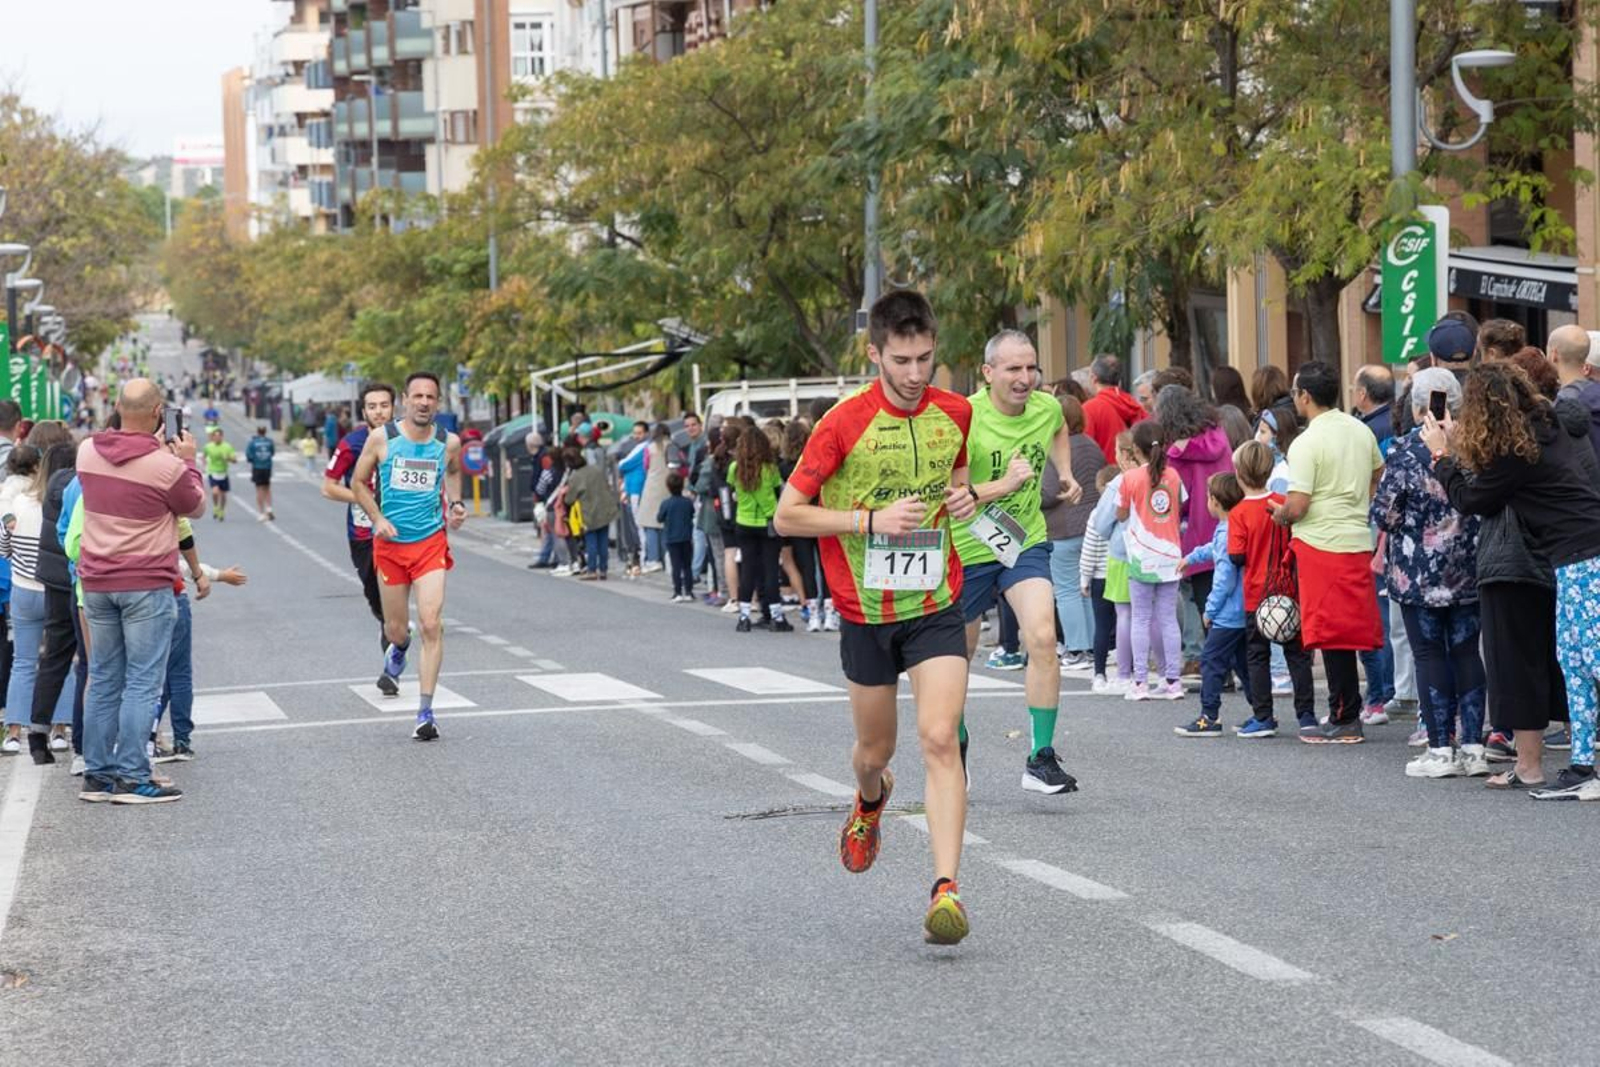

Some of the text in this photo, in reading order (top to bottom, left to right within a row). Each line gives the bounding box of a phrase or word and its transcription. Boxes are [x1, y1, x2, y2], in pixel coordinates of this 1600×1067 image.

[400, 471, 428, 485] 336
[988, 526, 1012, 552] 72
[884, 552, 927, 575] 171
